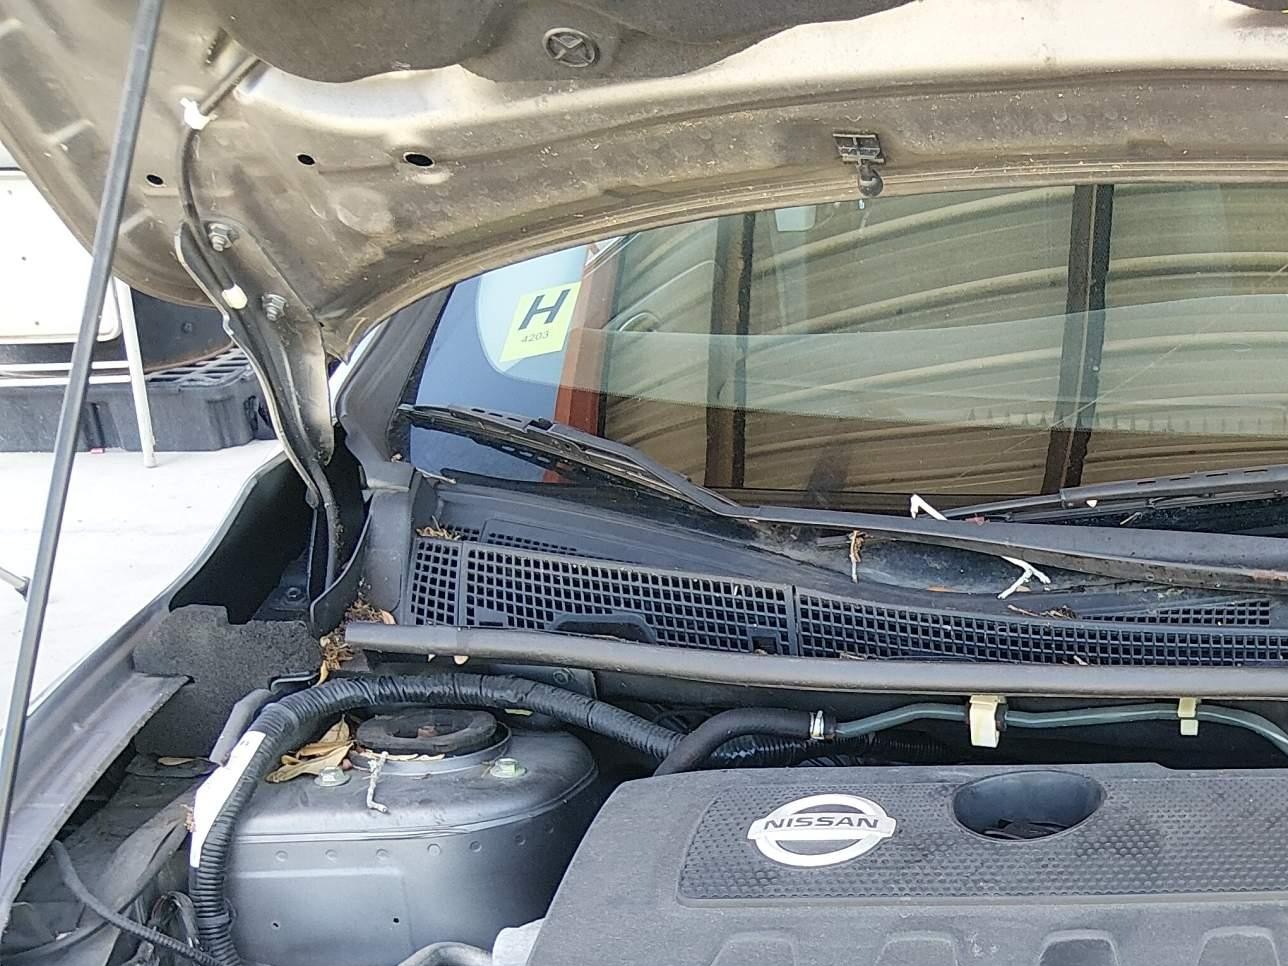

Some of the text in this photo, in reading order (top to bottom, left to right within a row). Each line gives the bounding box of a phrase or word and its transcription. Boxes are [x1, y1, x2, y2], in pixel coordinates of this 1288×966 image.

[518, 289, 571, 330] H
[520, 330, 550, 343] 4203
[763, 816, 880, 831] NISSAN
